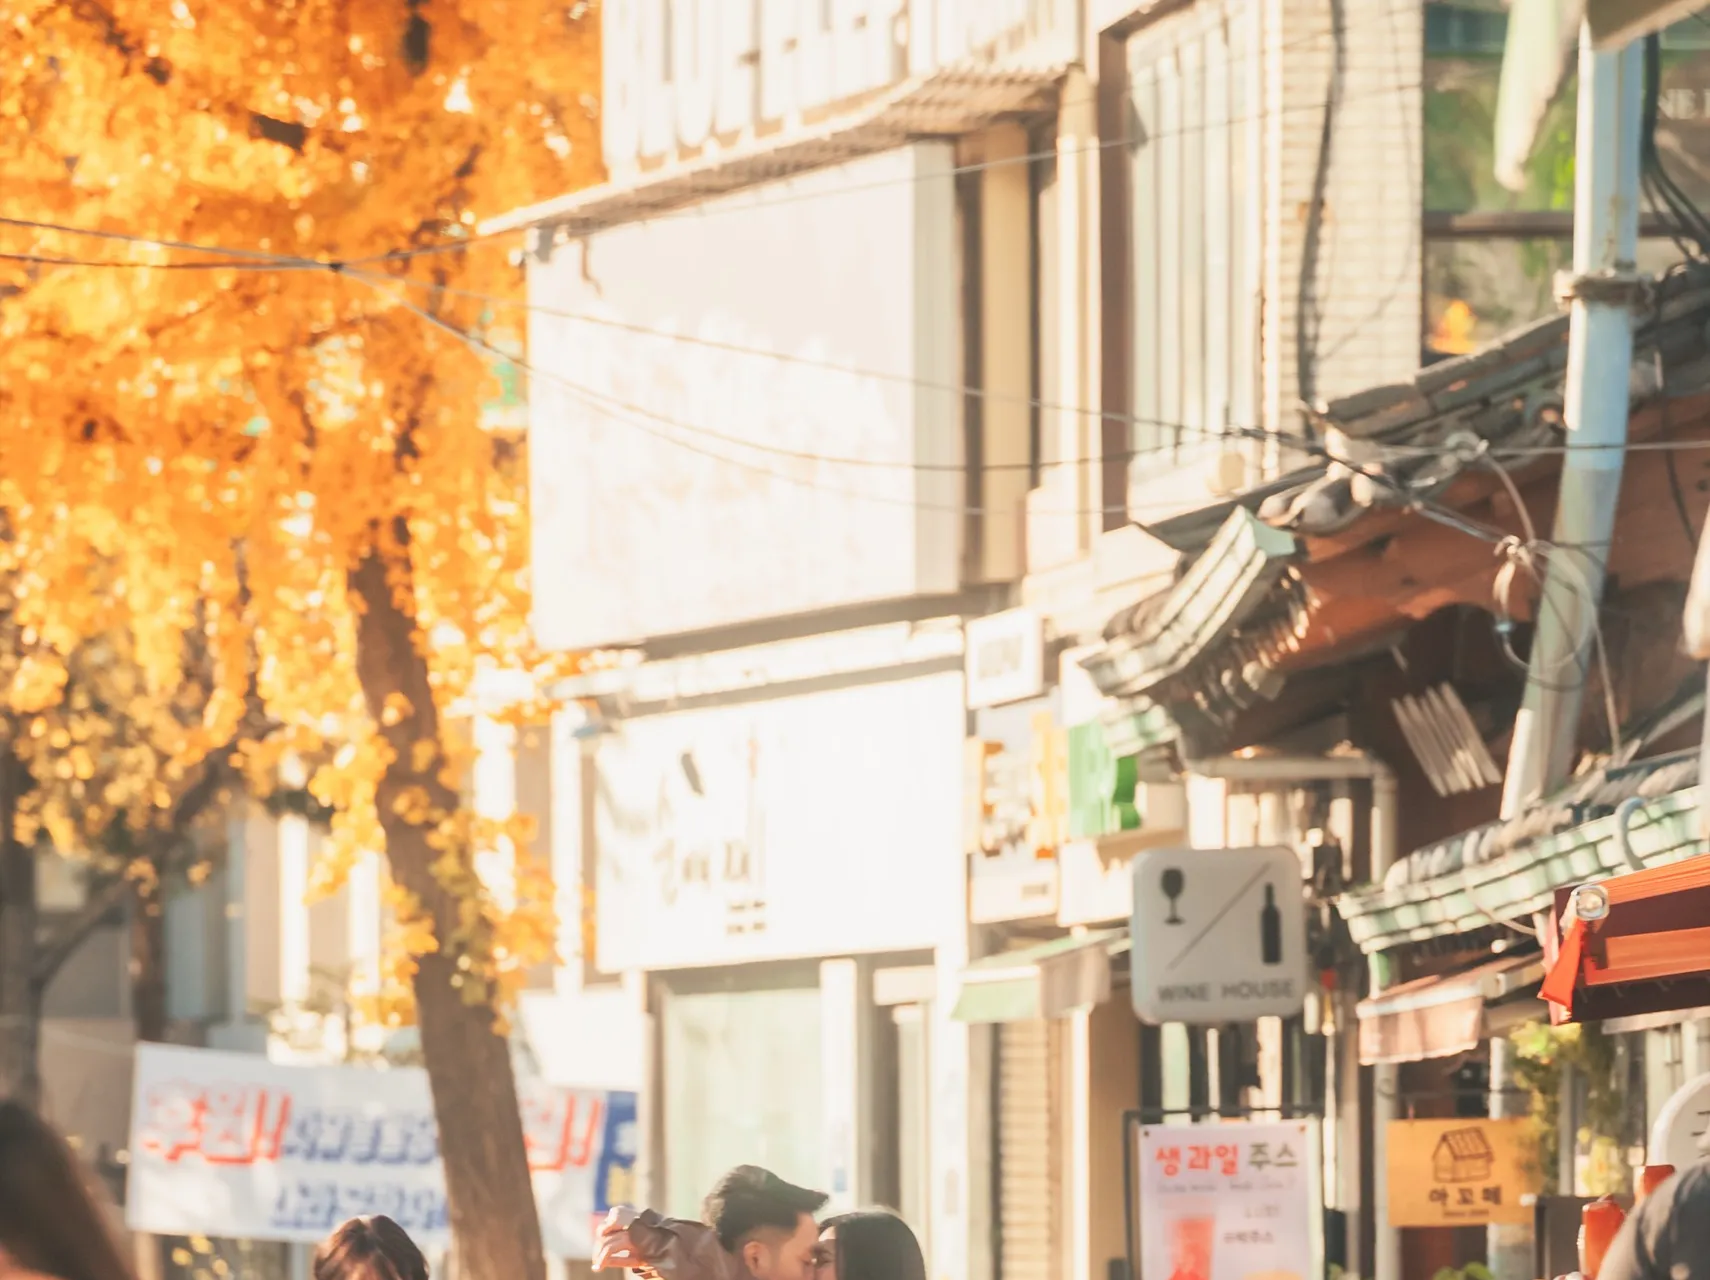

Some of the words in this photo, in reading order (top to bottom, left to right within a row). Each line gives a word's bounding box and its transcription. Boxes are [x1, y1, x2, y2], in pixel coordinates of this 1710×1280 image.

[1158, 981, 1210, 1003] WINE
[1221, 978, 1295, 1000] HOUSE
[1156, 1144, 1239, 1176] 생과일
[1248, 1142, 1298, 1171] 주스
